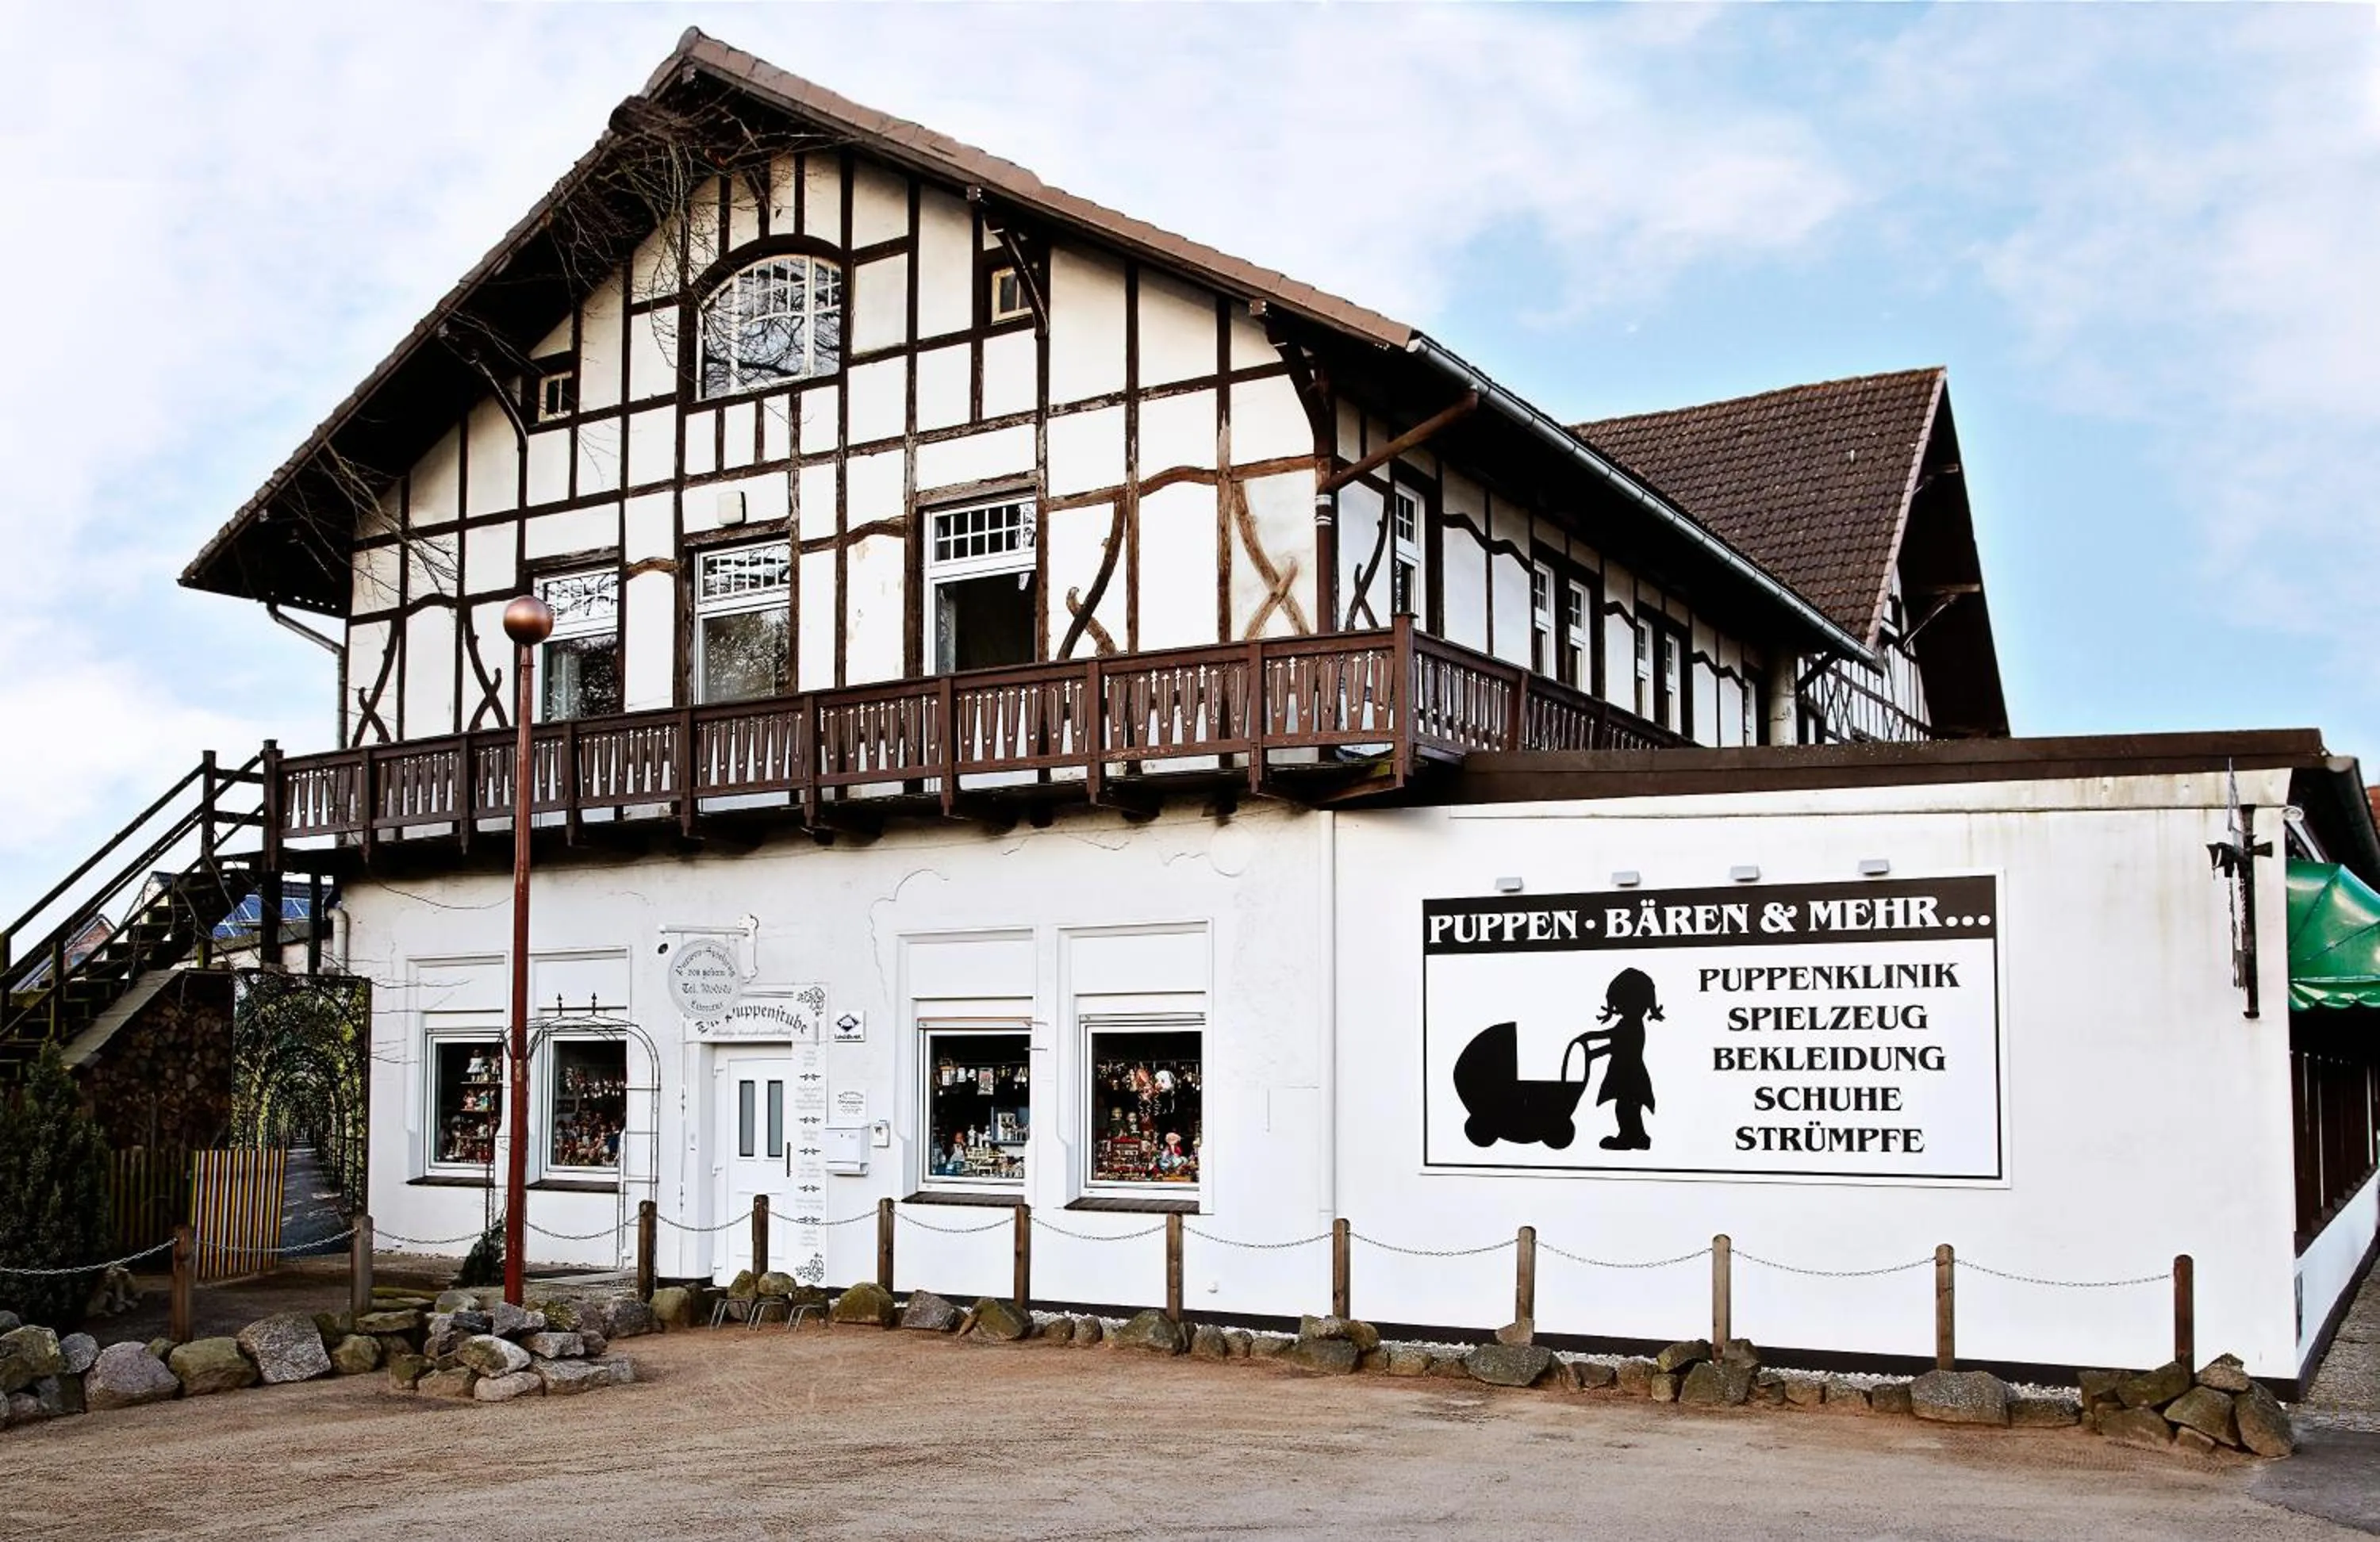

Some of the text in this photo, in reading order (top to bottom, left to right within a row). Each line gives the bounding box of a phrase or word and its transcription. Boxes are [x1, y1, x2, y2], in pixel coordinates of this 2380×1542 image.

[1428, 909, 1578, 944] PUPPEN
[1604, 898, 1750, 938] BÄREN
[1759, 902, 1798, 934] &
[1698, 963, 1960, 992] PUPPENKLINIK
[1727, 1004, 1928, 1032] SPIELZEUG
[1712, 1045, 1946, 1072] BEKLEIDUNG
[1753, 1086, 1902, 1111] SCHUHE
[1734, 1121, 1925, 1153] STRÜMPFE
